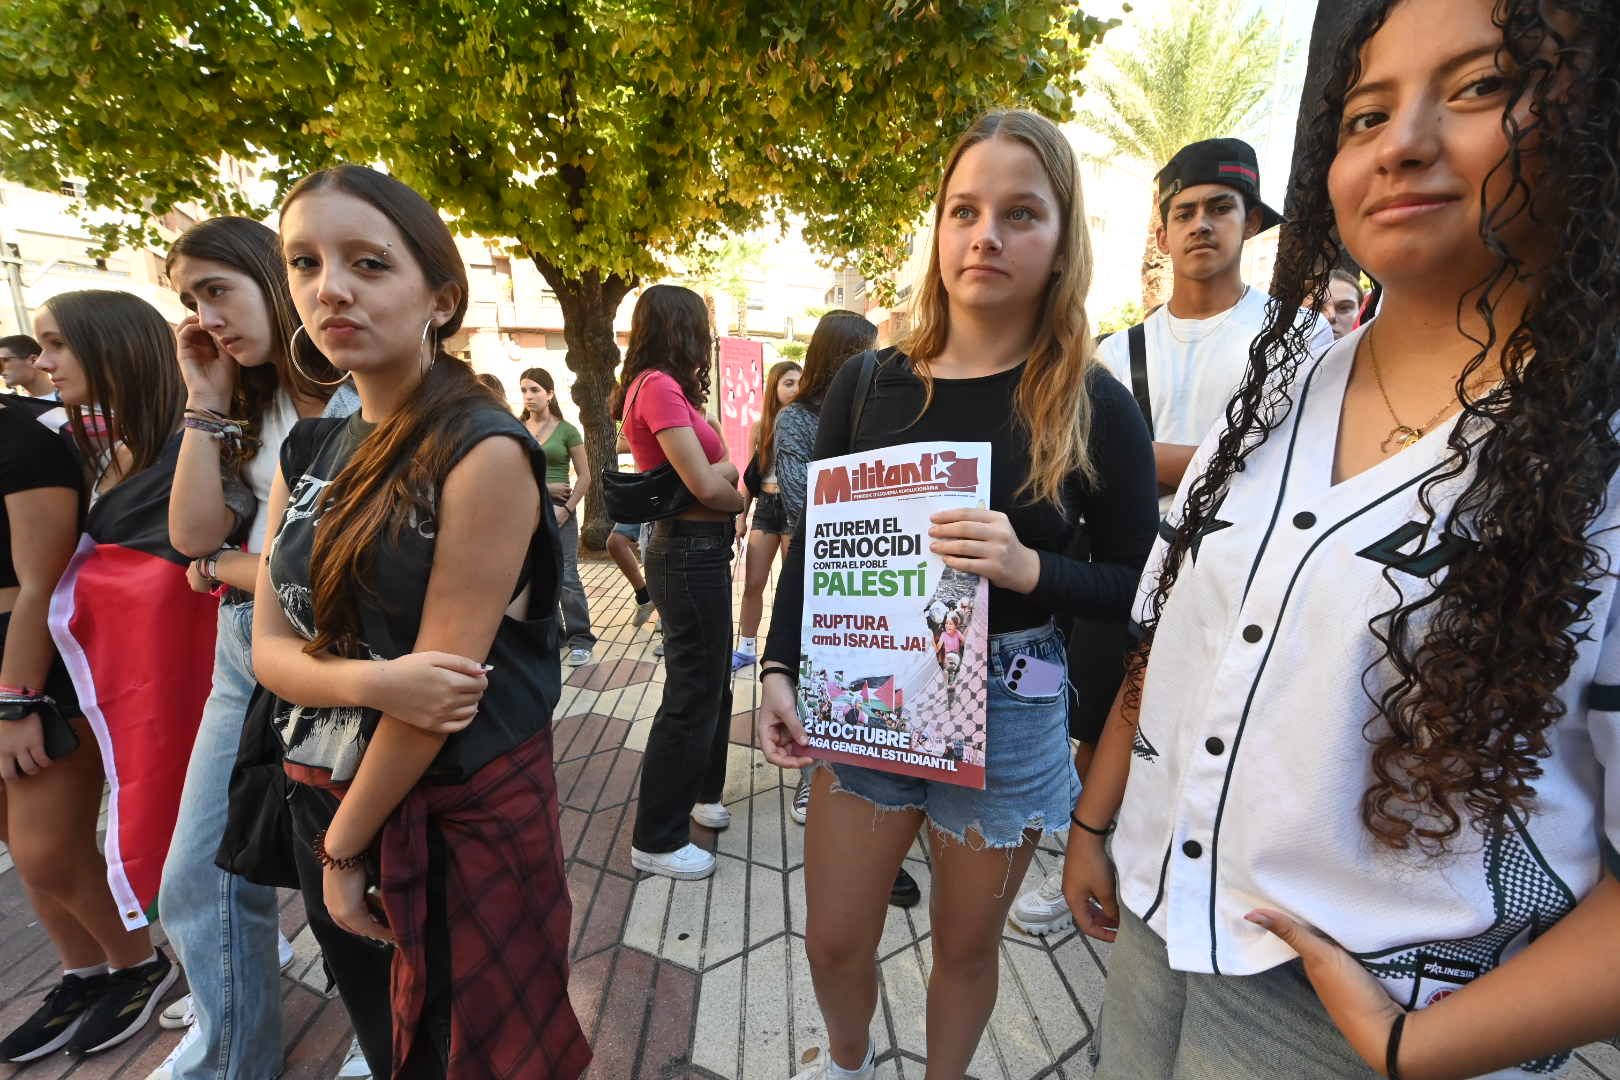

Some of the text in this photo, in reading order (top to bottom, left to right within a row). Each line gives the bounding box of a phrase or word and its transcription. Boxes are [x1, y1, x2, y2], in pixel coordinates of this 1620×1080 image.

[814, 453, 934, 505] Militant
[814, 517, 902, 538] ATUREM EL
[813, 534, 921, 560] GENOCIDI
[813, 559, 888, 570] CONTRA EL POBLE
[812, 561, 928, 597] PALESTÍ
[812, 613, 889, 631] RUPTURA
[812, 633, 926, 652] amb ISRAEL JA!
[804, 719, 911, 748] 2 d'OCTUBRE
[808, 736, 958, 772] AGA GENERAL ESTUDIANTIL
